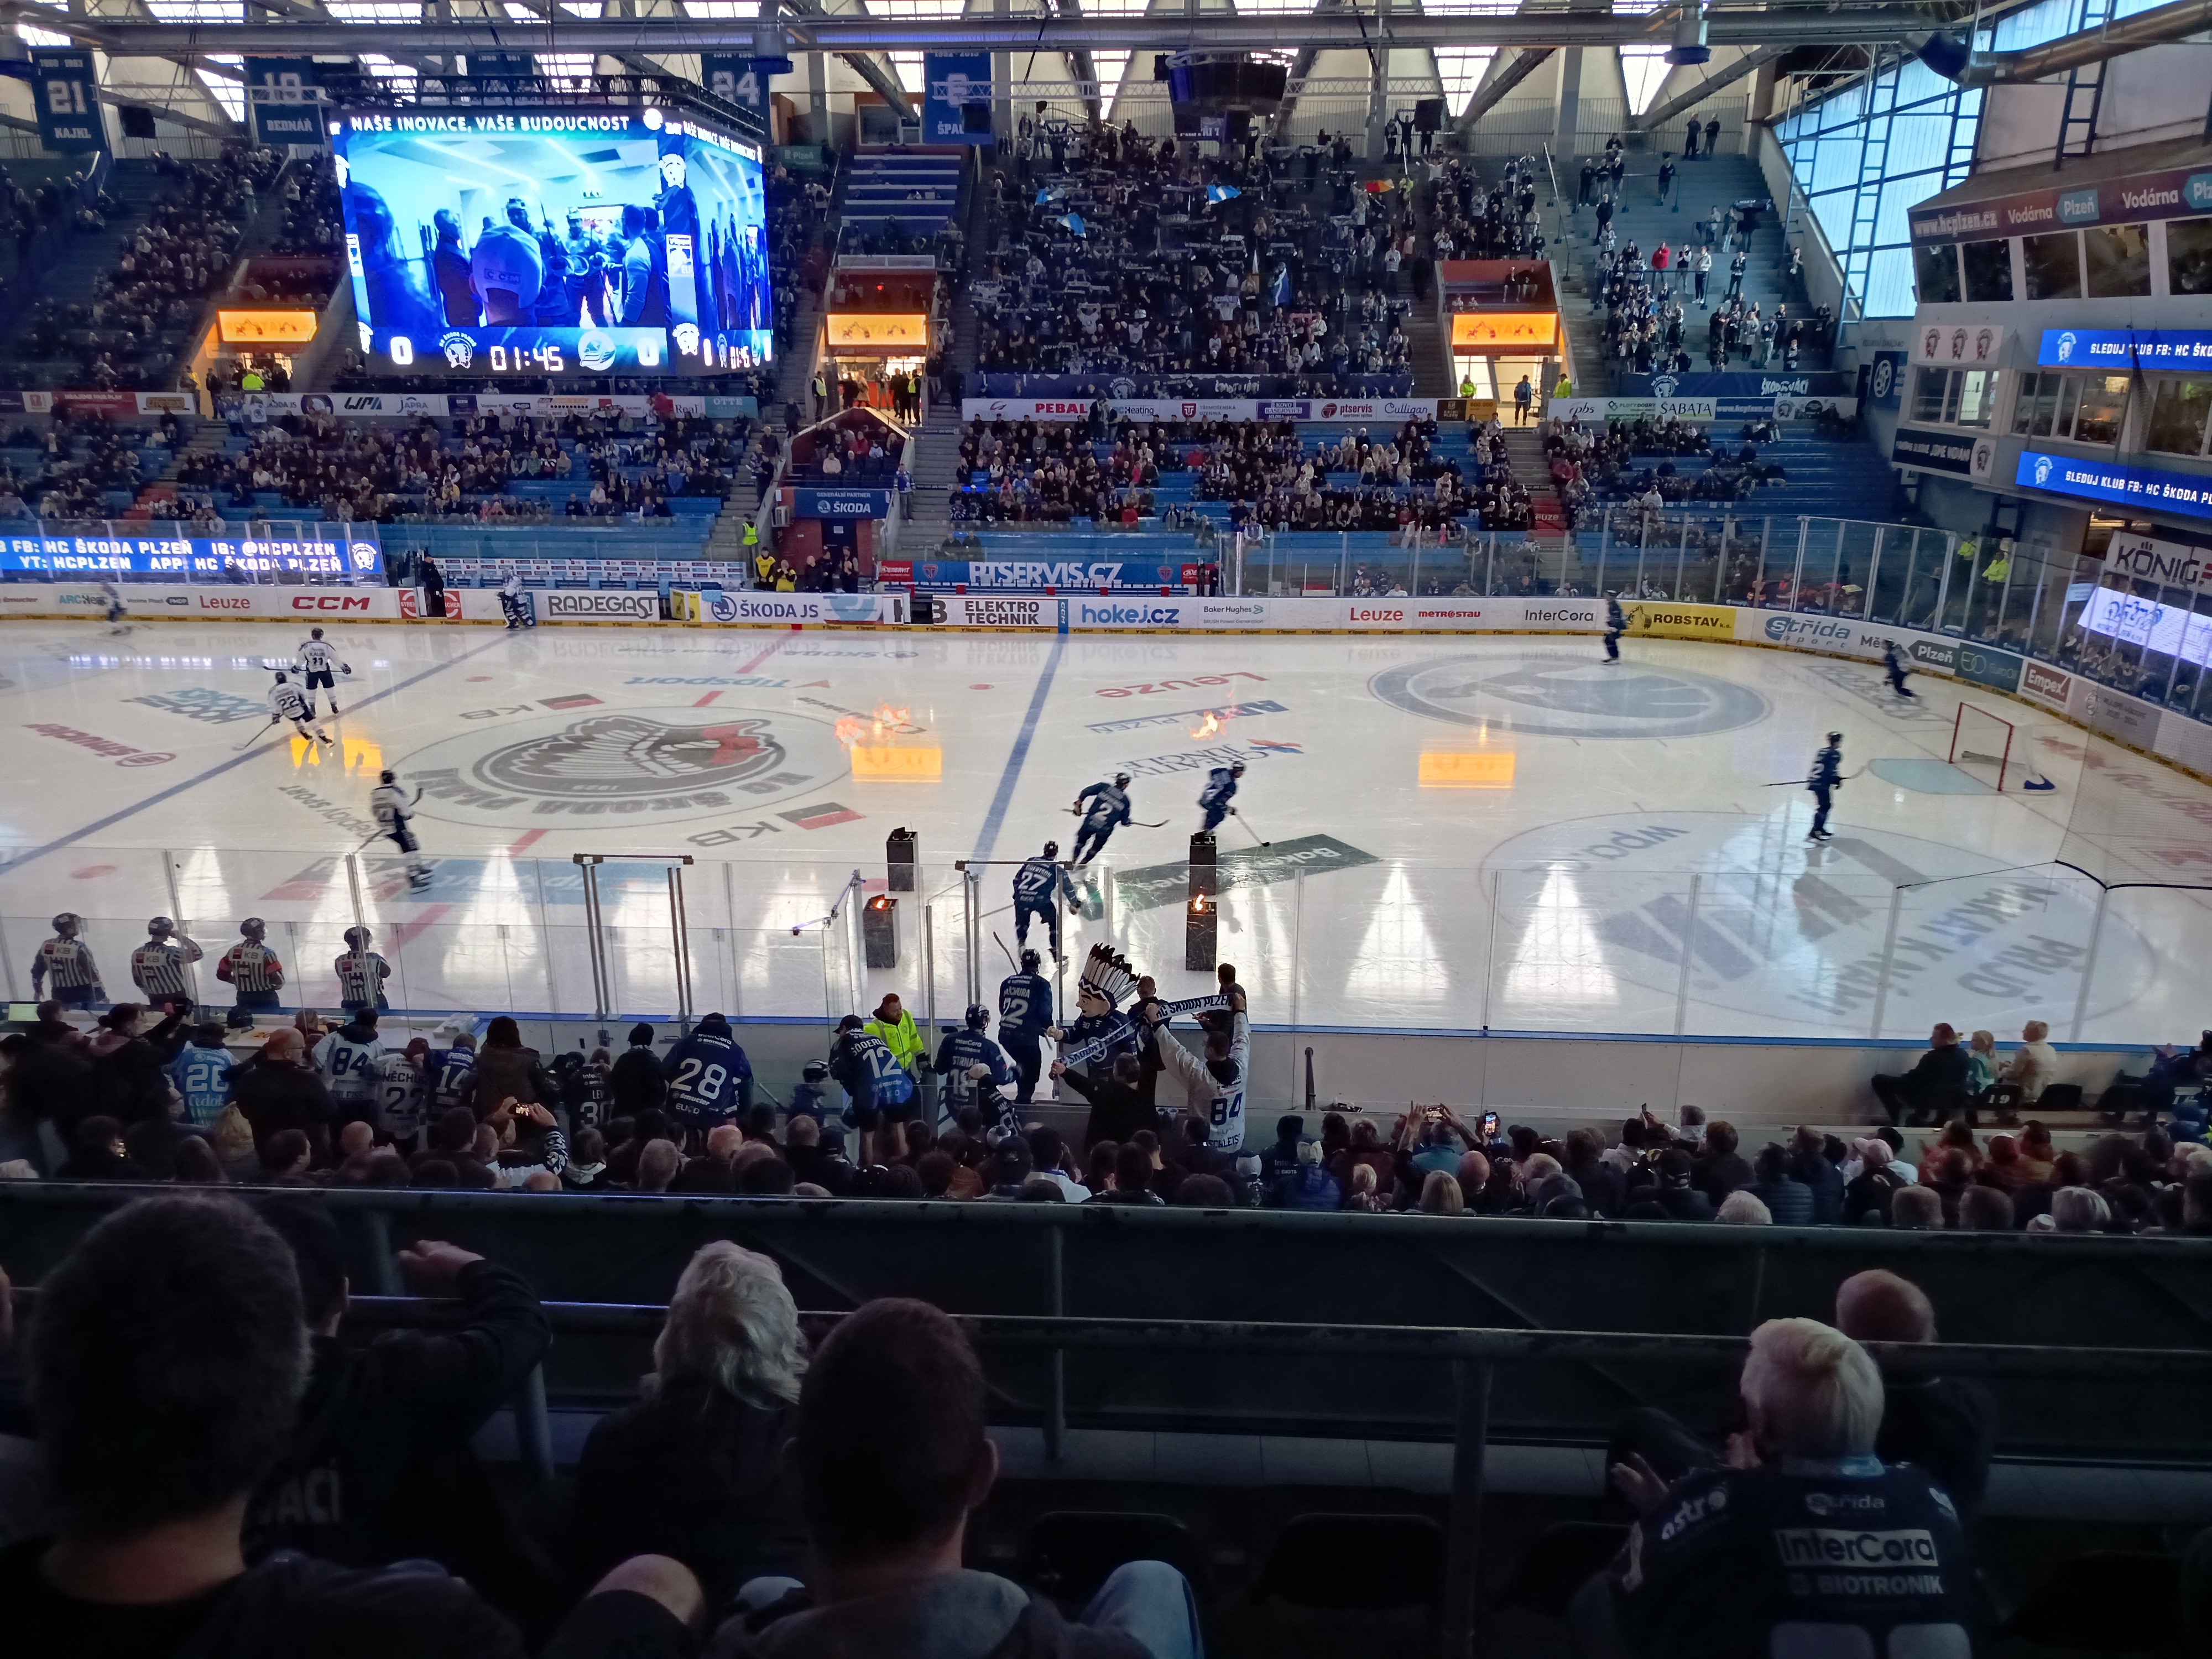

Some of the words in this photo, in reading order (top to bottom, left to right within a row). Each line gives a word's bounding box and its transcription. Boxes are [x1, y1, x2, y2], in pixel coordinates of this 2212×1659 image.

[48, 81, 87, 114] 21
[712, 70, 761, 106] 24
[352, 114, 392, 132] NAŠE
[397, 116, 472, 133] INOVACE,
[476, 114, 515, 132] VAŠE
[520, 115, 630, 132] BUDOUCNOST
[1914, 210, 1998, 237] www.hcplzen.cz
[2008, 205, 2053, 224] Vodárna
[2064, 195, 2095, 216] Plzeň
[2122, 187, 2179, 210] Vodárna
[390, 336, 413, 365] 0
[491, 346, 565, 372] 01:45
[637, 337, 660, 366] 0
[2090, 343, 2125, 355] SLEDUJ
[2156, 344, 2172, 356] FB:
[2175, 345, 2189, 357] HC
[714, 397, 743, 405] OTTE
[1035, 403, 1088, 414] PEBAL
[1340, 404, 1373, 416] ptservis
[1385, 401, 1428, 419] Culligan
[1660, 400, 1713, 417] ŠABATA
[2065, 471, 2099, 486] SLEDUJ
[2101, 476, 2125, 491] KLUB
[2127, 480, 2143, 493] FB:
[2146, 483, 2159, 496] HC
[2163, 484, 2198, 503] ŠKODA
[833, 500, 871, 513] ŠKODA
[12, 539, 41, 553] FB:
[46, 541, 70, 554] HC
[76, 538, 134, 555] ŠKODA
[139, 539, 193, 555] PLZEŇ
[211, 542, 236, 555] IG:
[242, 541, 336, 556] @HCPLZEN
[19, 556, 49, 570] YT:
[53, 556, 132, 570] HCPLZEN
[195, 558, 218, 571] HC
[969, 561, 1124, 585] PTSERVIS.CZ
[200, 594, 251, 609] Leuze
[292, 596, 371, 611] CCM
[547, 596, 658, 619] RADEGAST
[740, 599, 797, 618] ŠKODA
[800, 603, 819, 618] JS
[965, 601, 1040, 613] ELEKTRO
[1225, 606, 1252, 614] Hughes
[967, 613, 1040, 625] TECHNIK
[1082, 603, 1180, 624] hokej.cz
[1350, 607, 1404, 622] Leuze
[1525, 609, 1594, 622] InterCora
[1653, 613, 1720, 628] ROBSTAV
[1917, 645, 1954, 664] Plzeň
[1094, 672, 1270, 698] Leuze
[277, 785, 331, 808] SPORT
[686, 821, 782, 847] KB
[1018, 871, 1048, 891] 27
[244, 951, 258, 959] KB
[332, 1046, 370, 1076] 84
[862, 1046, 902, 1079] 12
[670, 1057, 727, 1100] 28
[1210, 1091, 1243, 1126] 84
[1989, 1094, 2011, 1104] 19
[1778, 1532, 1936, 1563] InterCora
[1816, 1575, 1944, 1595] BIOTRONIK
